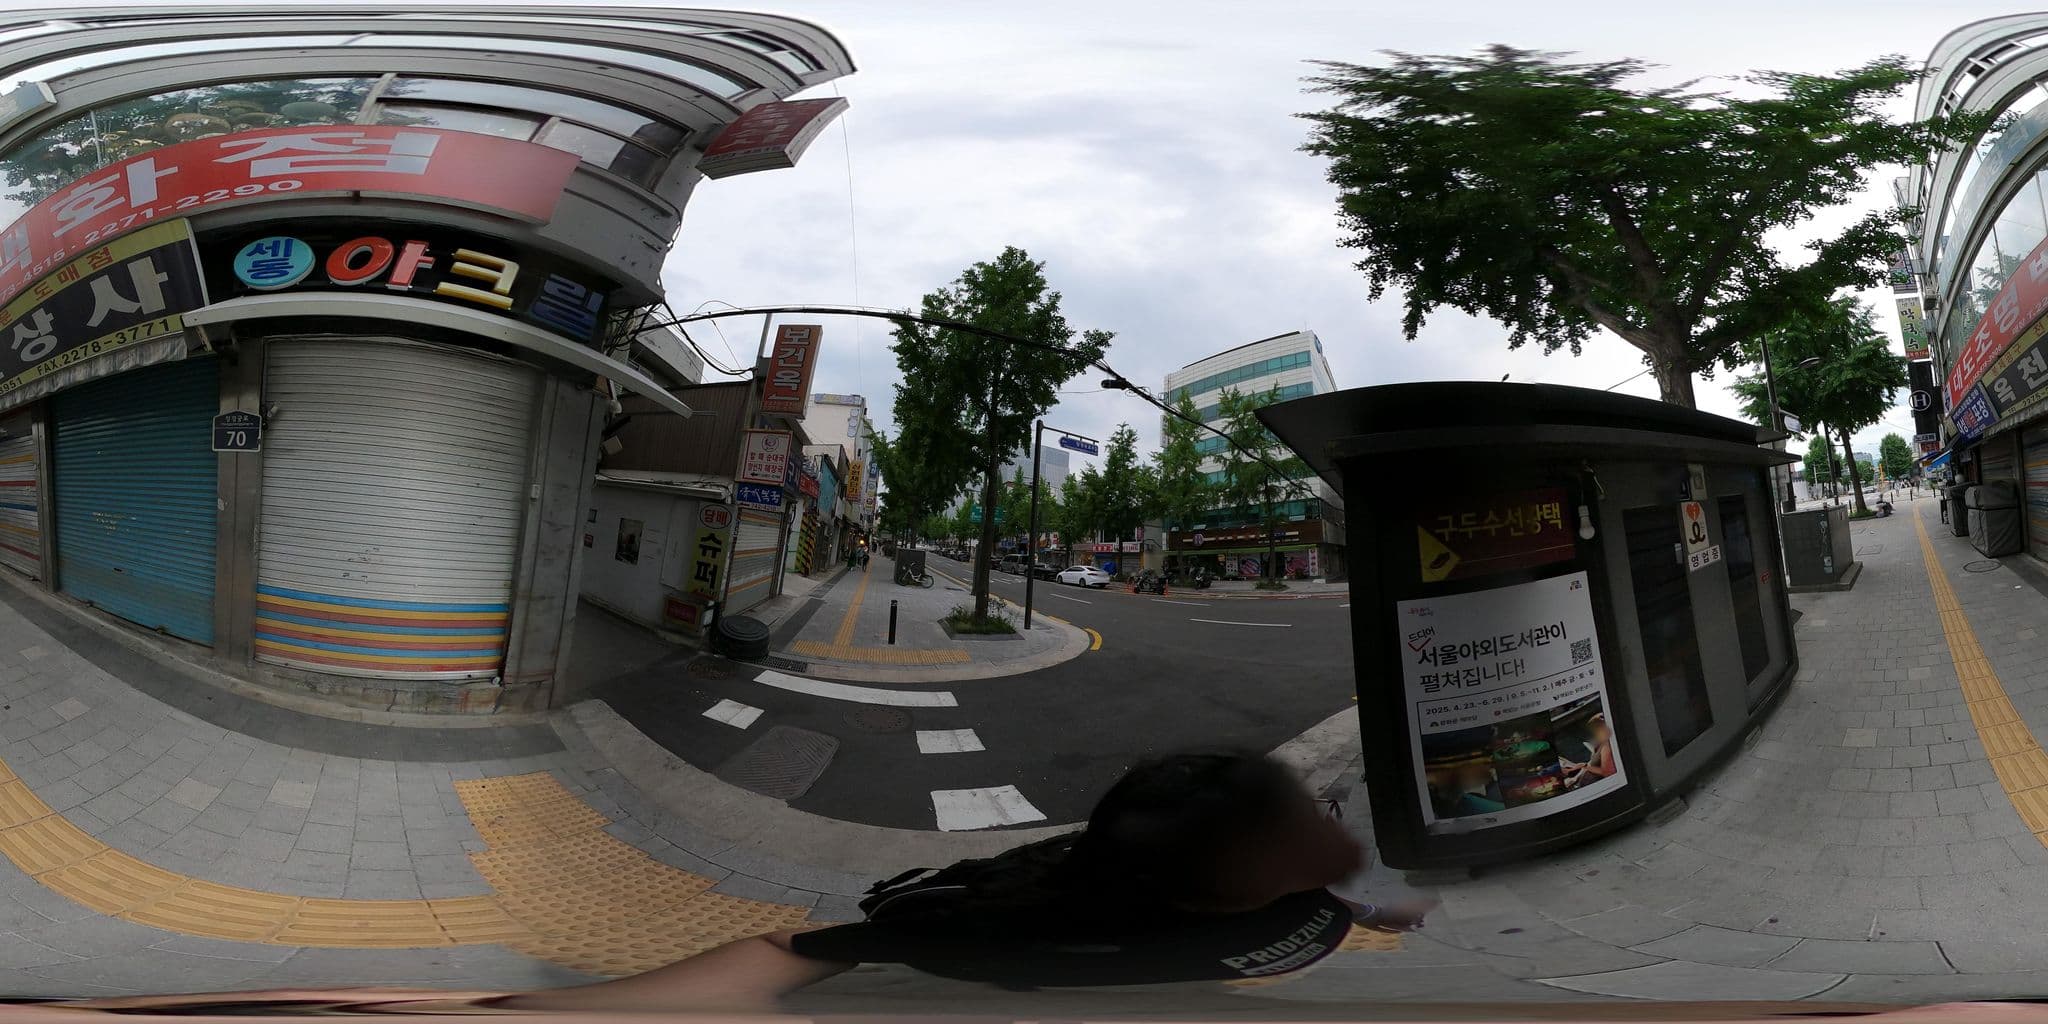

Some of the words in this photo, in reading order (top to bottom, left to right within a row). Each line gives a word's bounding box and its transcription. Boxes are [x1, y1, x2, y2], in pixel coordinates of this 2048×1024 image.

[84, 179, 303, 244] 2271-2290
[326, 236, 605, 341] 아크릴
[0, 256, 168, 378] 상사
[1899, 308, 1919, 350] 막국수
[36, 318, 171, 375] FAX.2278-3771
[772, 328, 810, 391] 보건옥
[226, 430, 247, 447] 70
[704, 509, 728, 525] 담배
[694, 532, 722, 590] 슈퍼
[1691, 547, 1719, 568] 영업중
[1408, 626, 1436, 643] 드디어
[1417, 621, 1566, 667] 서울야외도서관이
[1420, 658, 1526, 693] 펼쳐집니다!
[1426, 705, 1450, 715] 2025.
[1219, 907, 1336, 969] PRIDEZILLA
